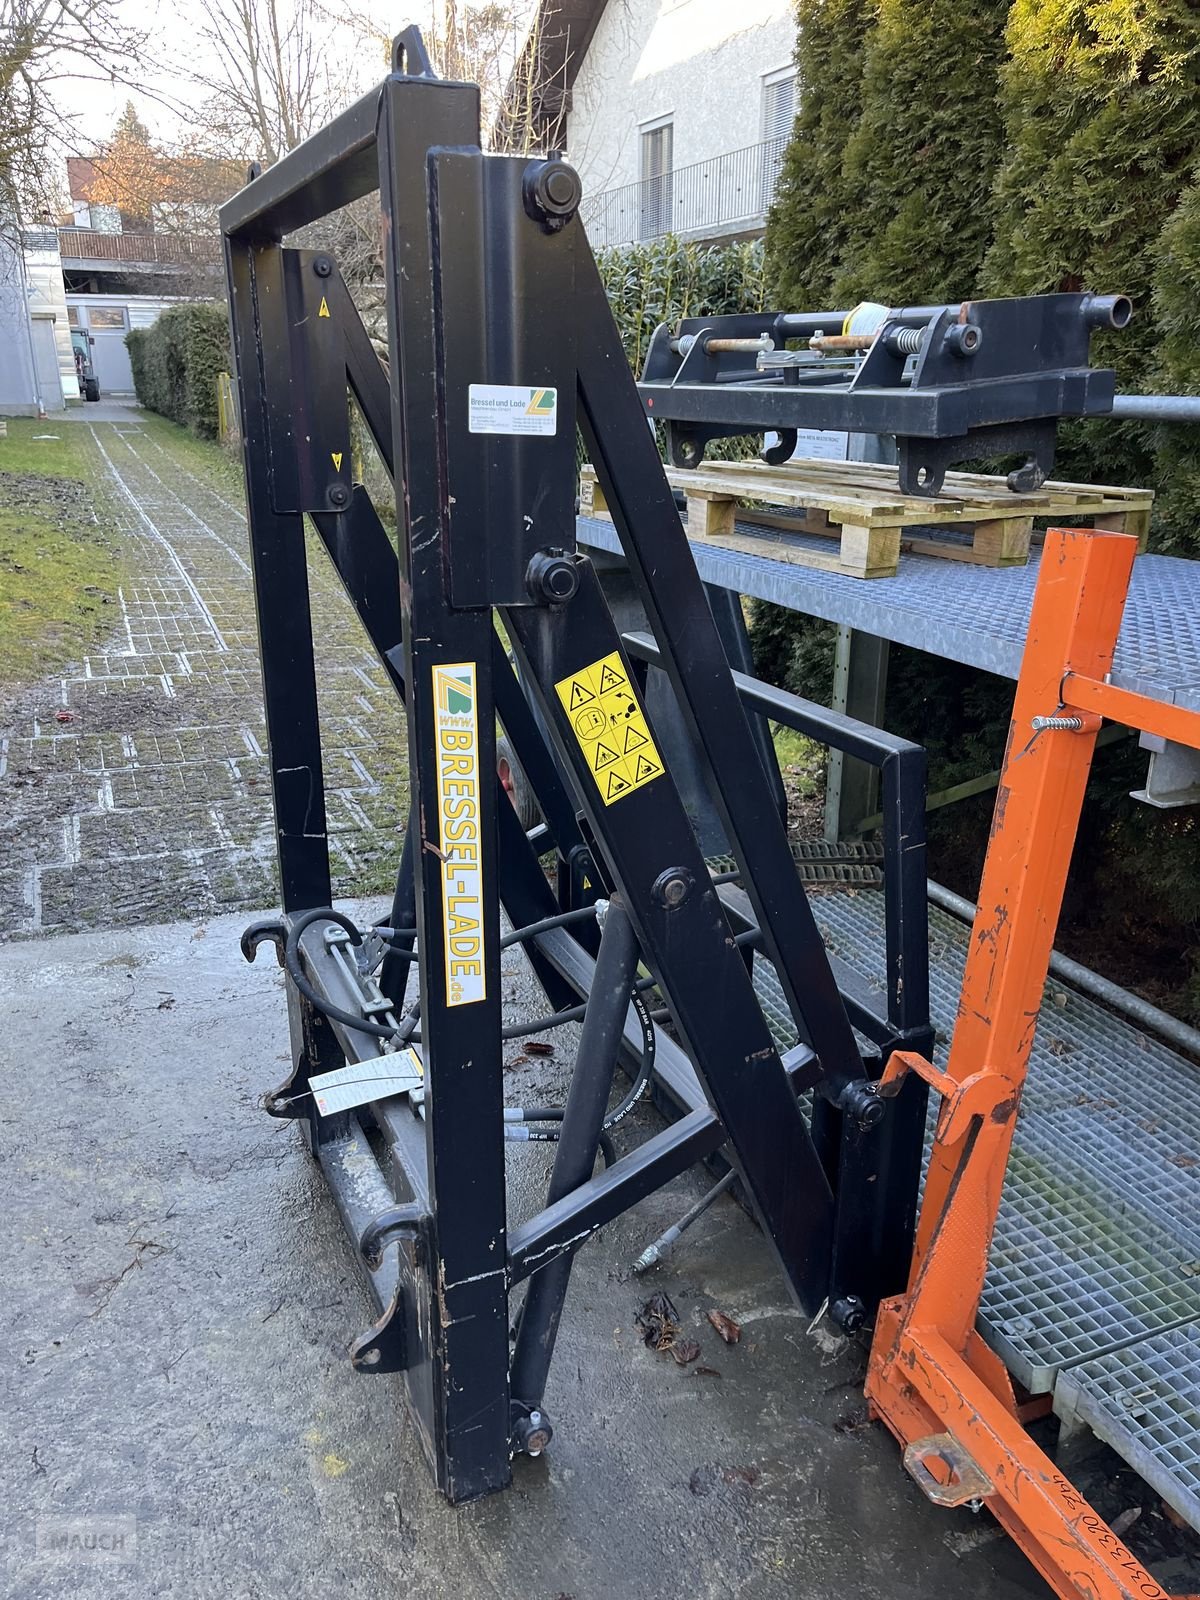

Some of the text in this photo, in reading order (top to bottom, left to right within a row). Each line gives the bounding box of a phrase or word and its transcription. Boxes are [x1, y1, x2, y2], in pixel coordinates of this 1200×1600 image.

[471, 398, 494, 406] Bressel
[510, 400, 526, 408] Lade
[632, 1078, 648, 1101] BRESSEL
[625, 1101, 636, 1112] UND
[614, 1109, 627, 1122] LADE
